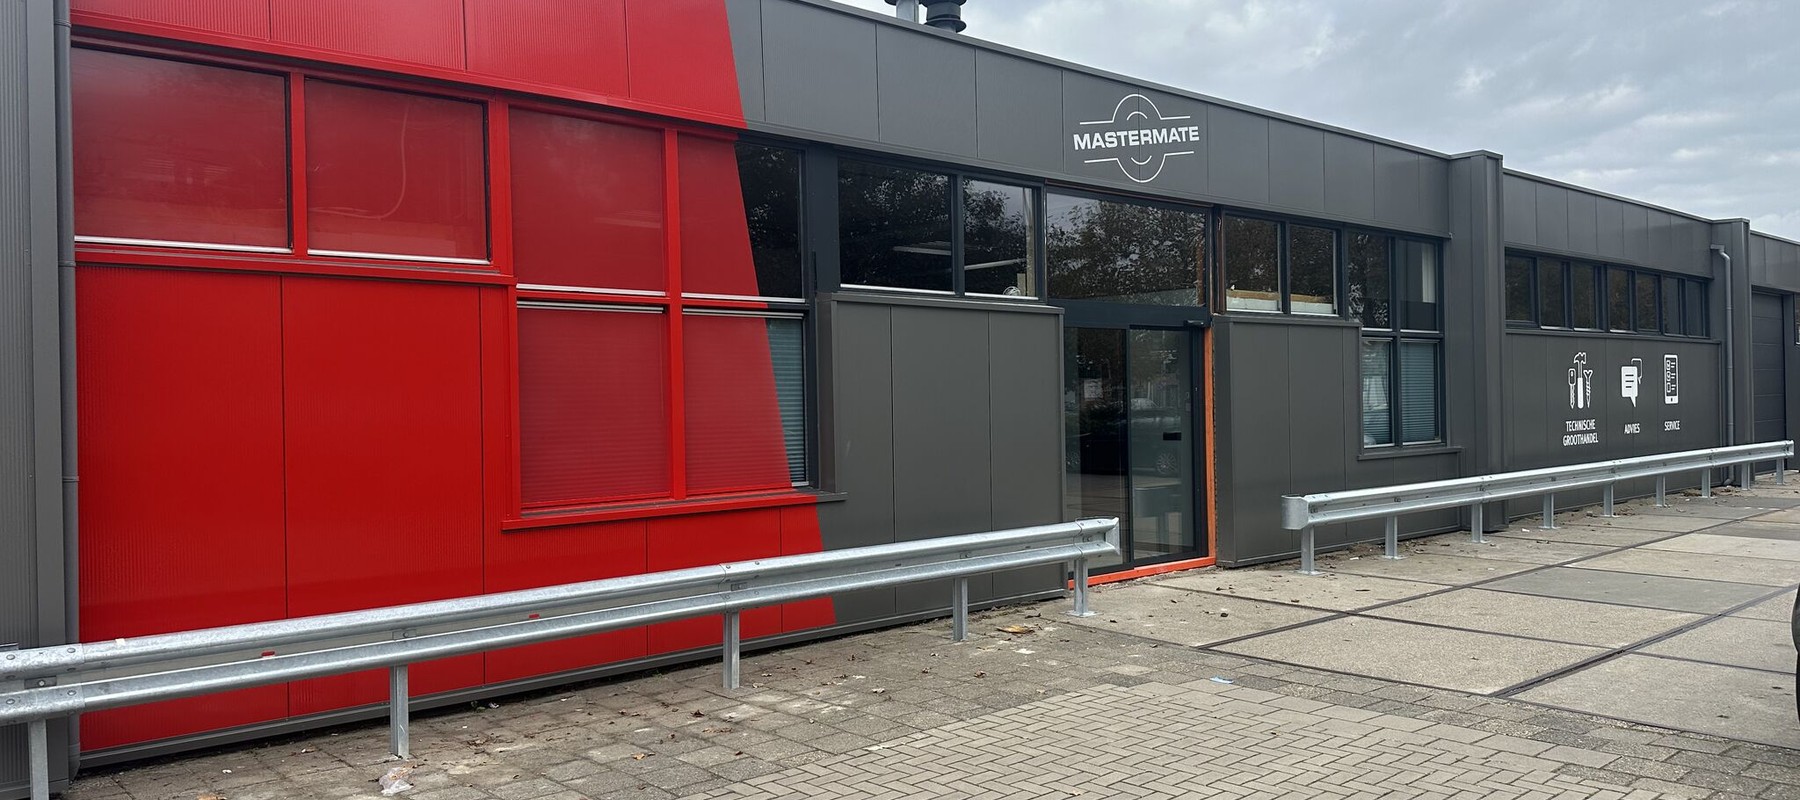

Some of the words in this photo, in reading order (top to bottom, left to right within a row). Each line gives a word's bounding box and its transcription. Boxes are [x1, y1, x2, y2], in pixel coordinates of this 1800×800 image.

[1073, 126, 1200, 151] MASTERMATE
[1566, 419, 1596, 432] TECHNISCHE
[1624, 423, 1640, 434] ADVIES
[1664, 420, 1681, 431] SERVICE
[1563, 432, 1599, 446] GROOTHANDEL
